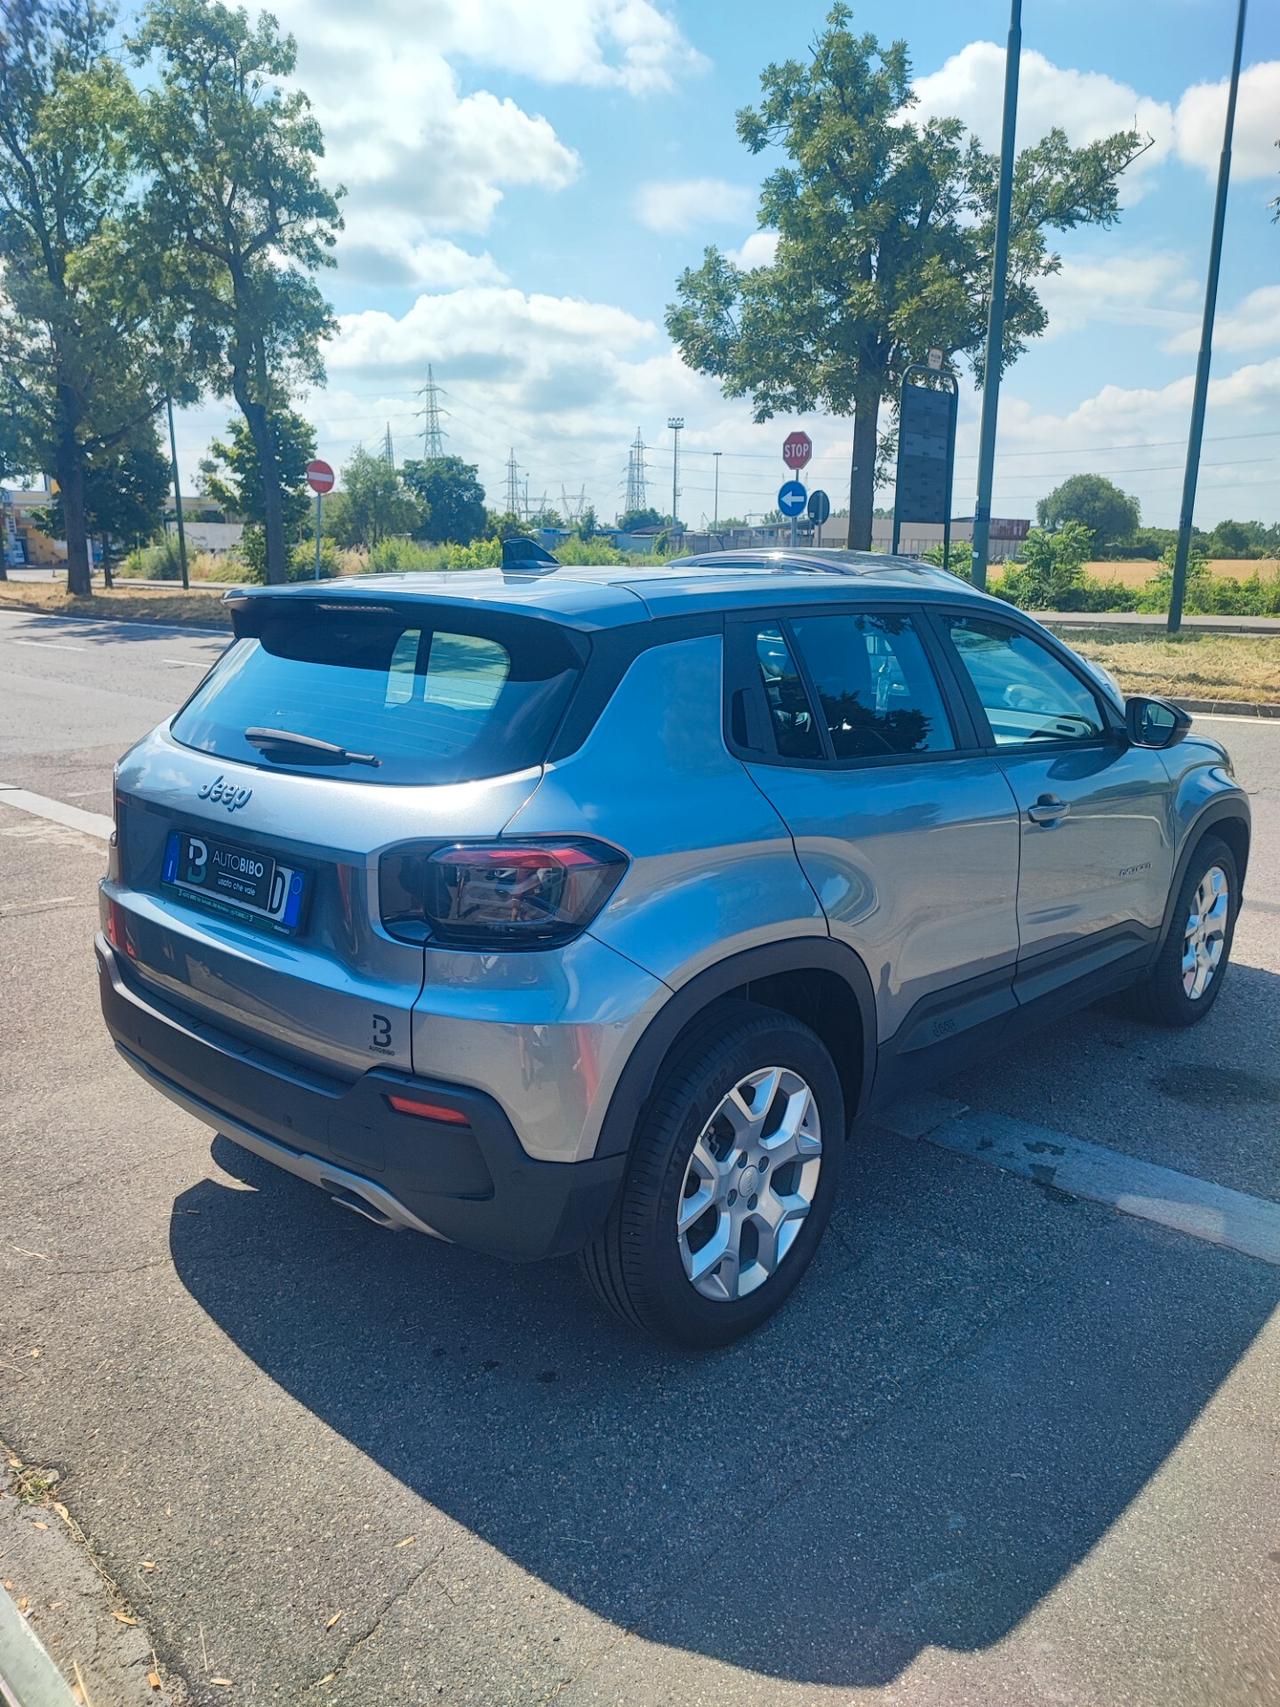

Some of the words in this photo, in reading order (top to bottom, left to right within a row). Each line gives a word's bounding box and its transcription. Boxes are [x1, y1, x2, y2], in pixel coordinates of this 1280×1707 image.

[785, 443, 809, 458] STOP
[198, 775, 252, 812] Jeep
[212, 850, 264, 878] AUTOBIBO
[233, 882, 244, 893] che
